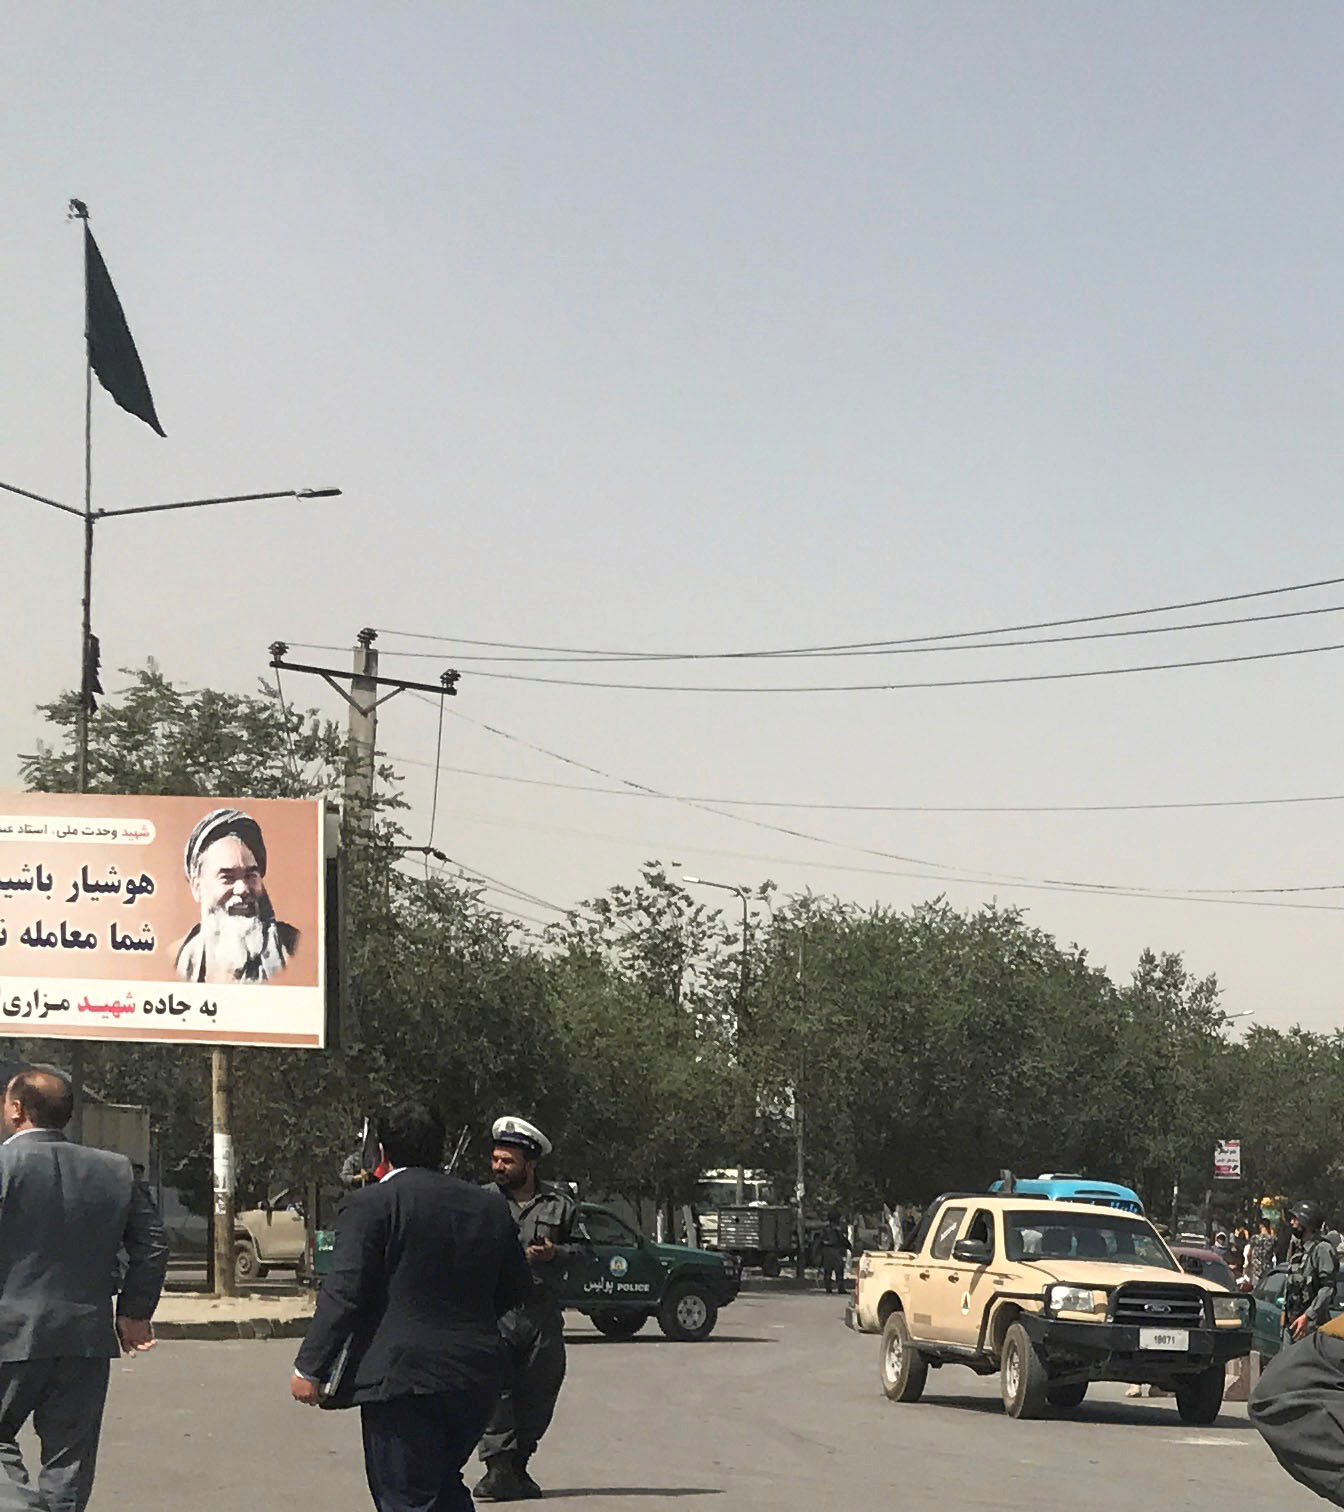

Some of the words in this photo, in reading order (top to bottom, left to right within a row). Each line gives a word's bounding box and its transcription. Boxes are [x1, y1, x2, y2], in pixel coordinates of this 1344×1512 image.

[17, 823, 48, 837] استاد
[81, 826, 118, 840] وحدت
[121, 825, 150, 840] شهید
[0, 863, 53, 901] باشی
[65, 863, 155, 905] هوشیار
[20, 919, 98, 950] معامله
[110, 920, 155, 952] شما
[2, 989, 71, 1018] مزاری
[77, 992, 136, 1019] شهید
[143, 993, 192, 1022] جاده
[199, 999, 218, 1024] به
[583, 1276, 614, 1294] پولیس
[616, 1283, 650, 1292] POLICE
